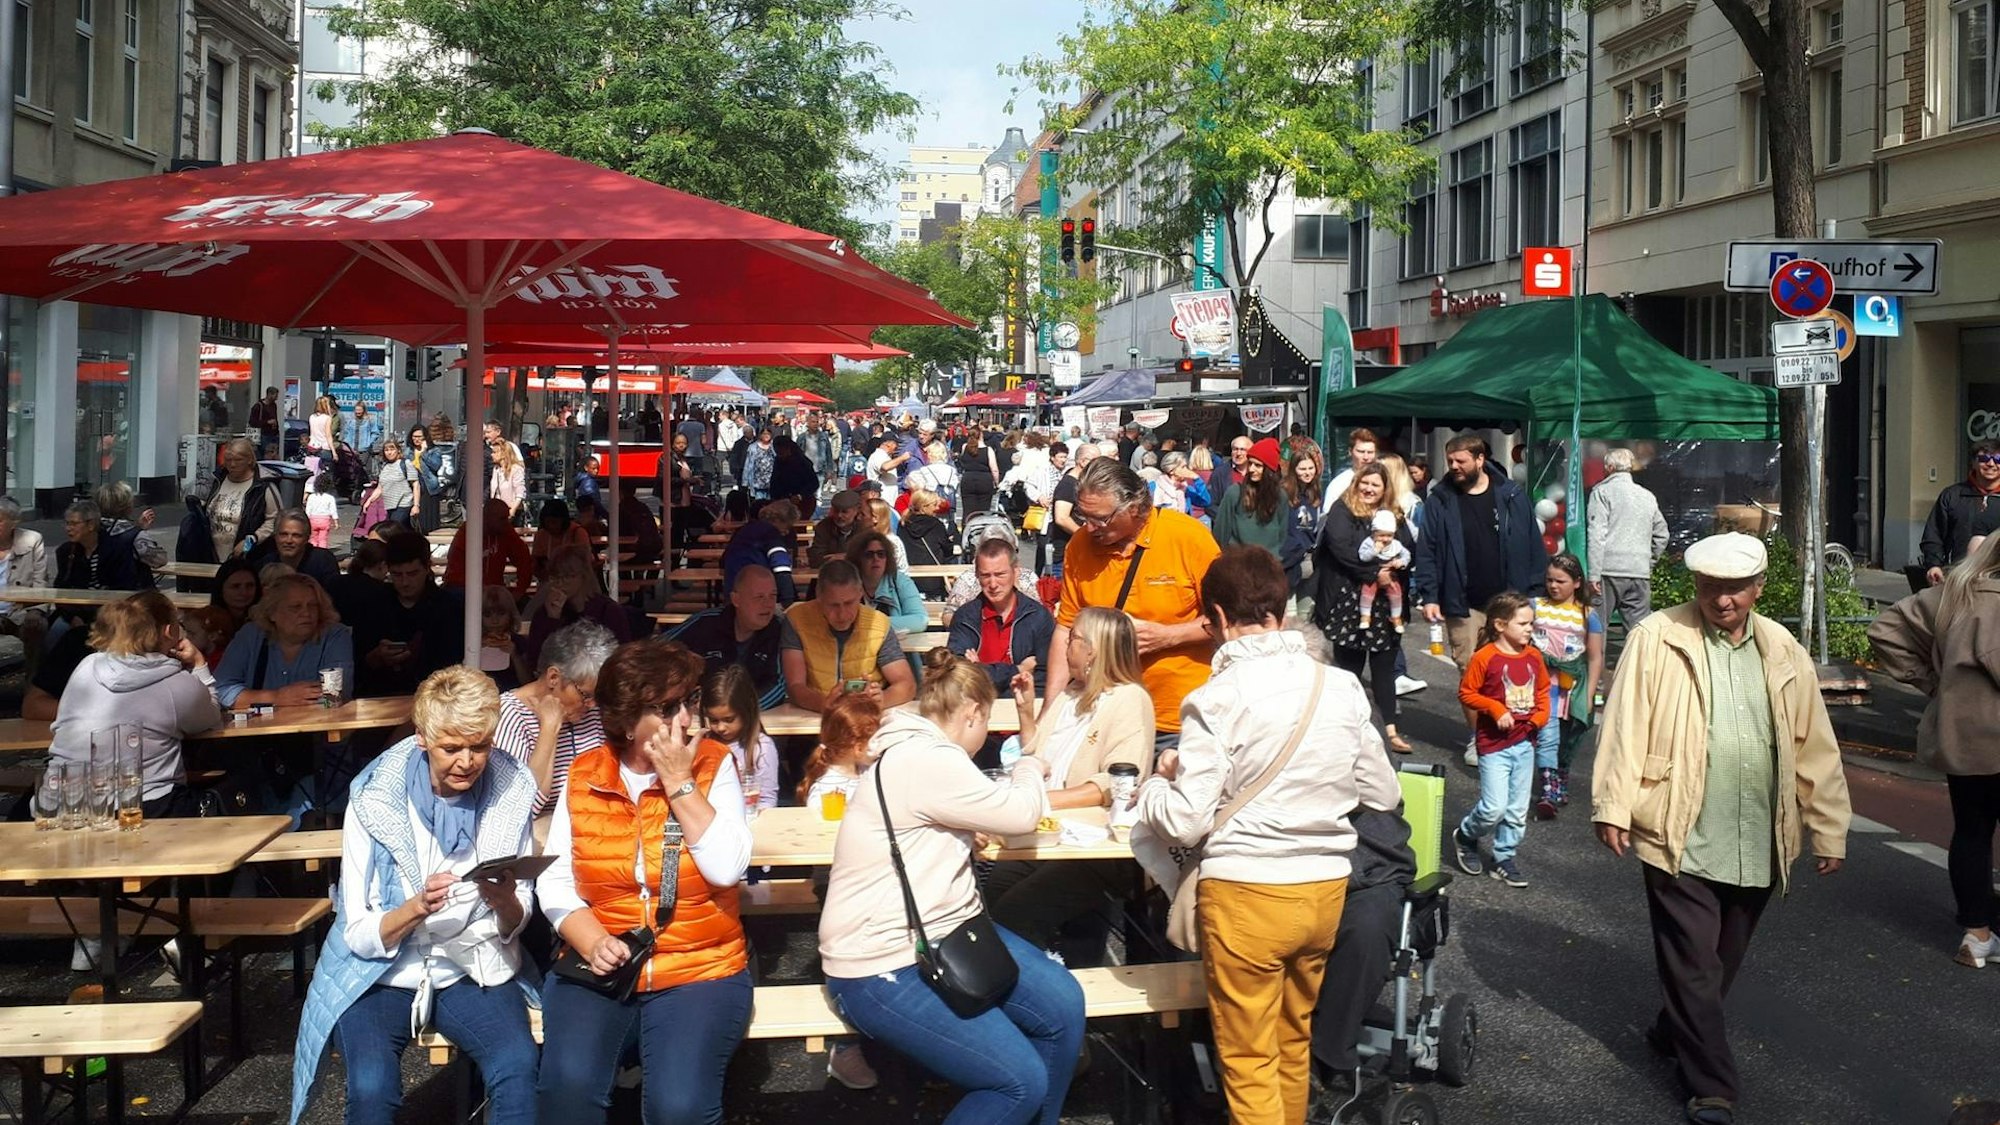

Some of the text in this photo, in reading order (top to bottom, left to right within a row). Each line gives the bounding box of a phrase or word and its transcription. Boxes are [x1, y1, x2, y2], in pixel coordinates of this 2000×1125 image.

[1202, 208, 1216, 263] KAUFH
[1806, 257, 1886, 276] aufhof
[1177, 296, 1230, 328] Crêpes
[1781, 358, 1810, 367] 09.09.22
[1782, 374, 1810, 383] 12.09.22
[1181, 409, 1220, 419] CRPES
